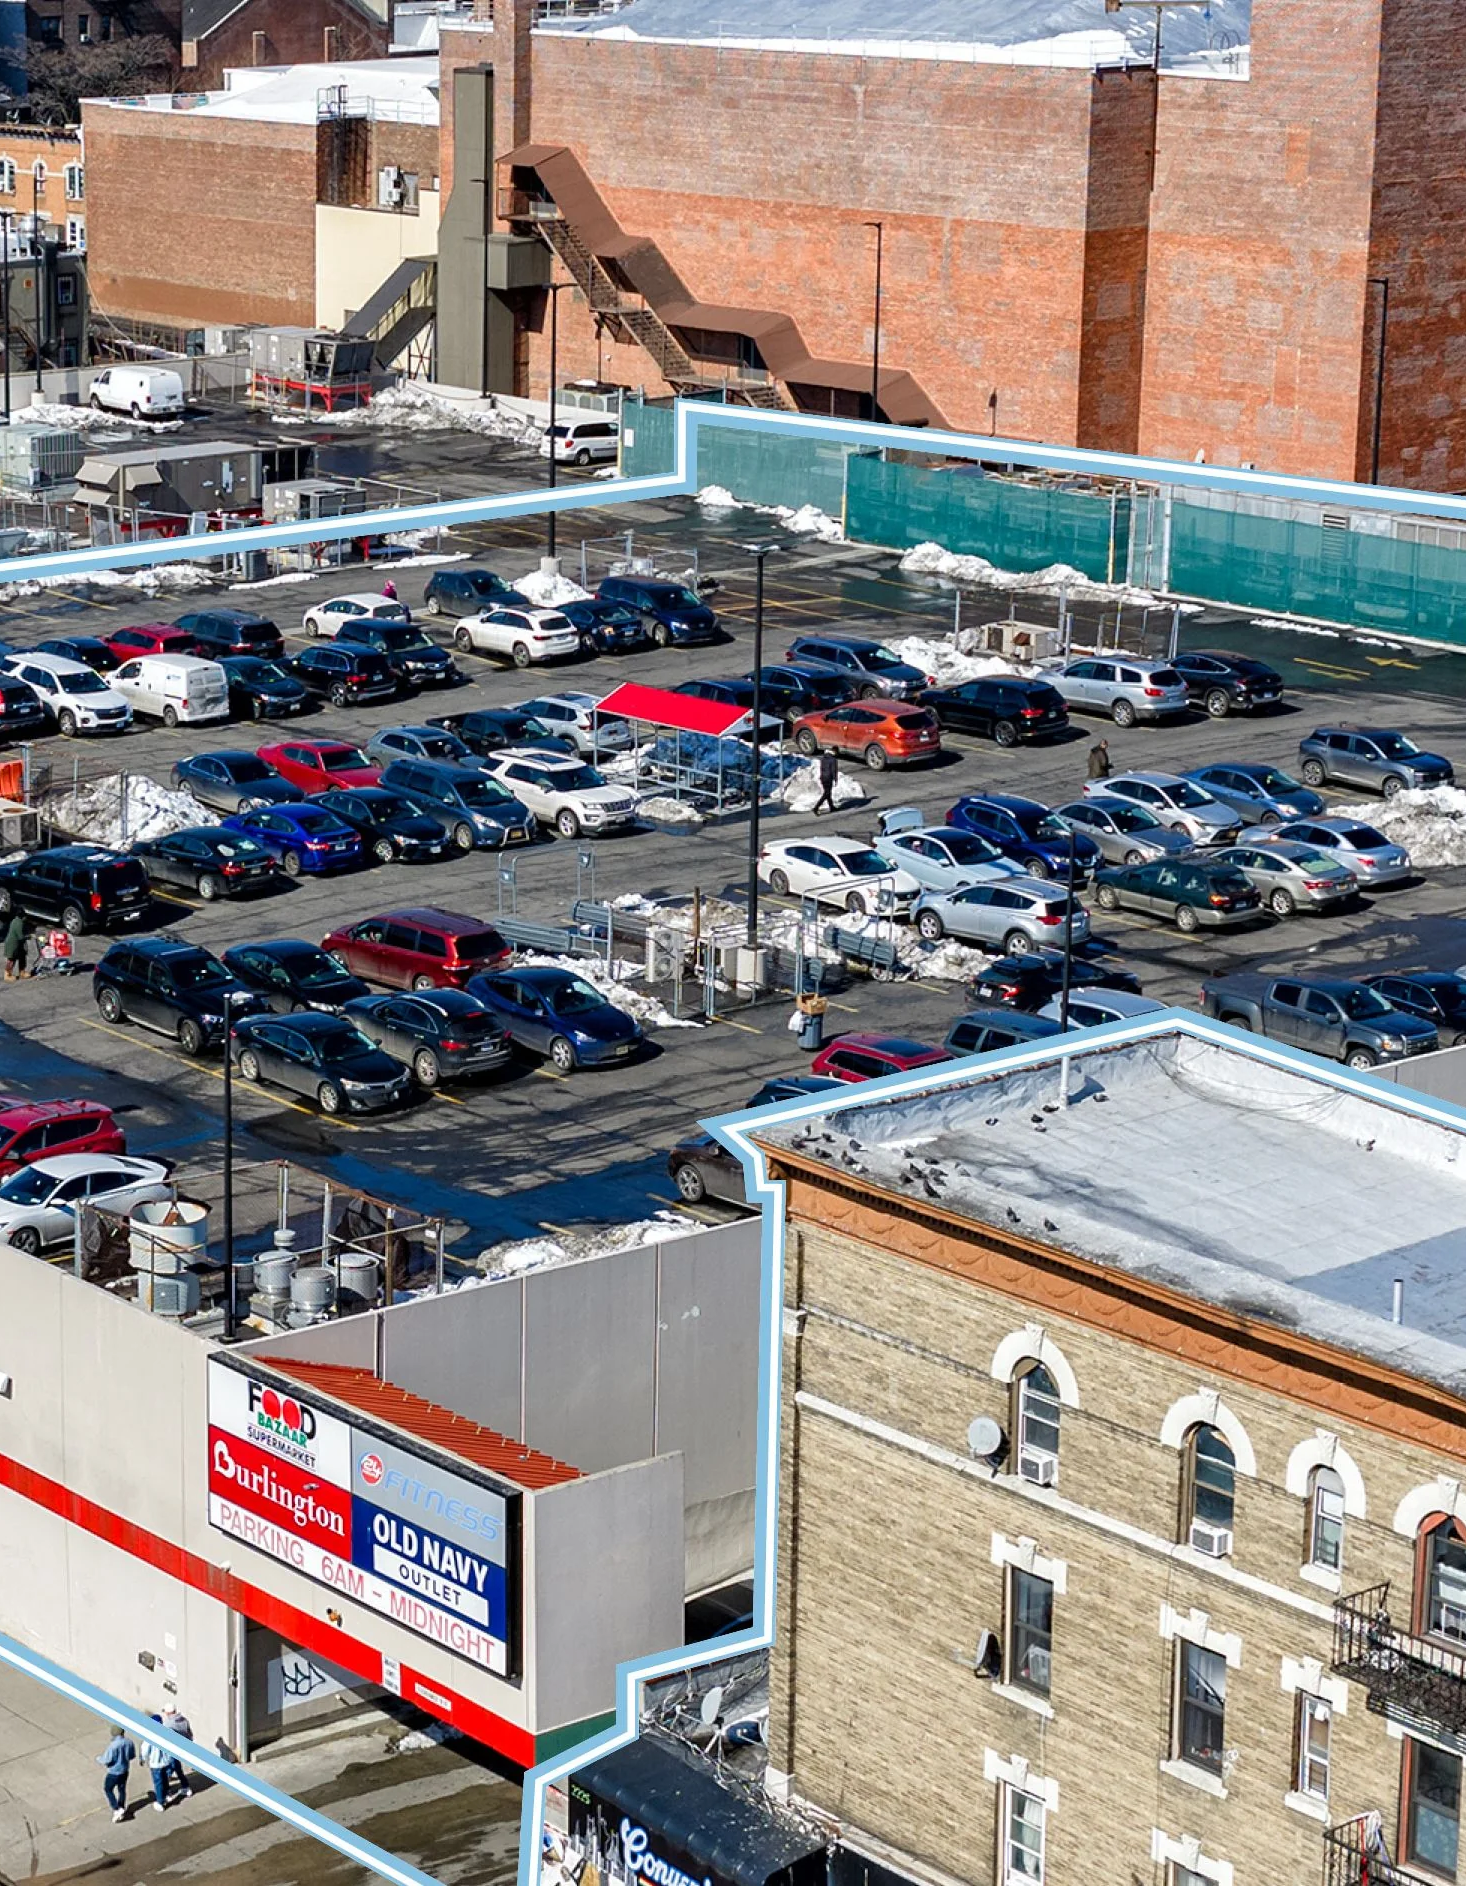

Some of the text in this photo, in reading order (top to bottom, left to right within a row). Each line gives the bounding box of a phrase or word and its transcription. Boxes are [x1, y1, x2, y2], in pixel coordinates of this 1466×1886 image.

[248, 1379, 317, 1440] FOOD
[257, 1411, 308, 1449] BAZAAR
[247, 1425, 316, 1467] SUPERMARKET
[214, 1440, 345, 1537] Burlington
[384, 1469, 503, 1541] FITNESS
[220, 1503, 305, 1567] PARKING
[321, 1555, 365, 1598] 6AM
[390, 1590, 495, 1664] MIDNIGHT
[374, 1513, 488, 1593] OLD NAVY
[399, 1563, 461, 1605] OUTLET
